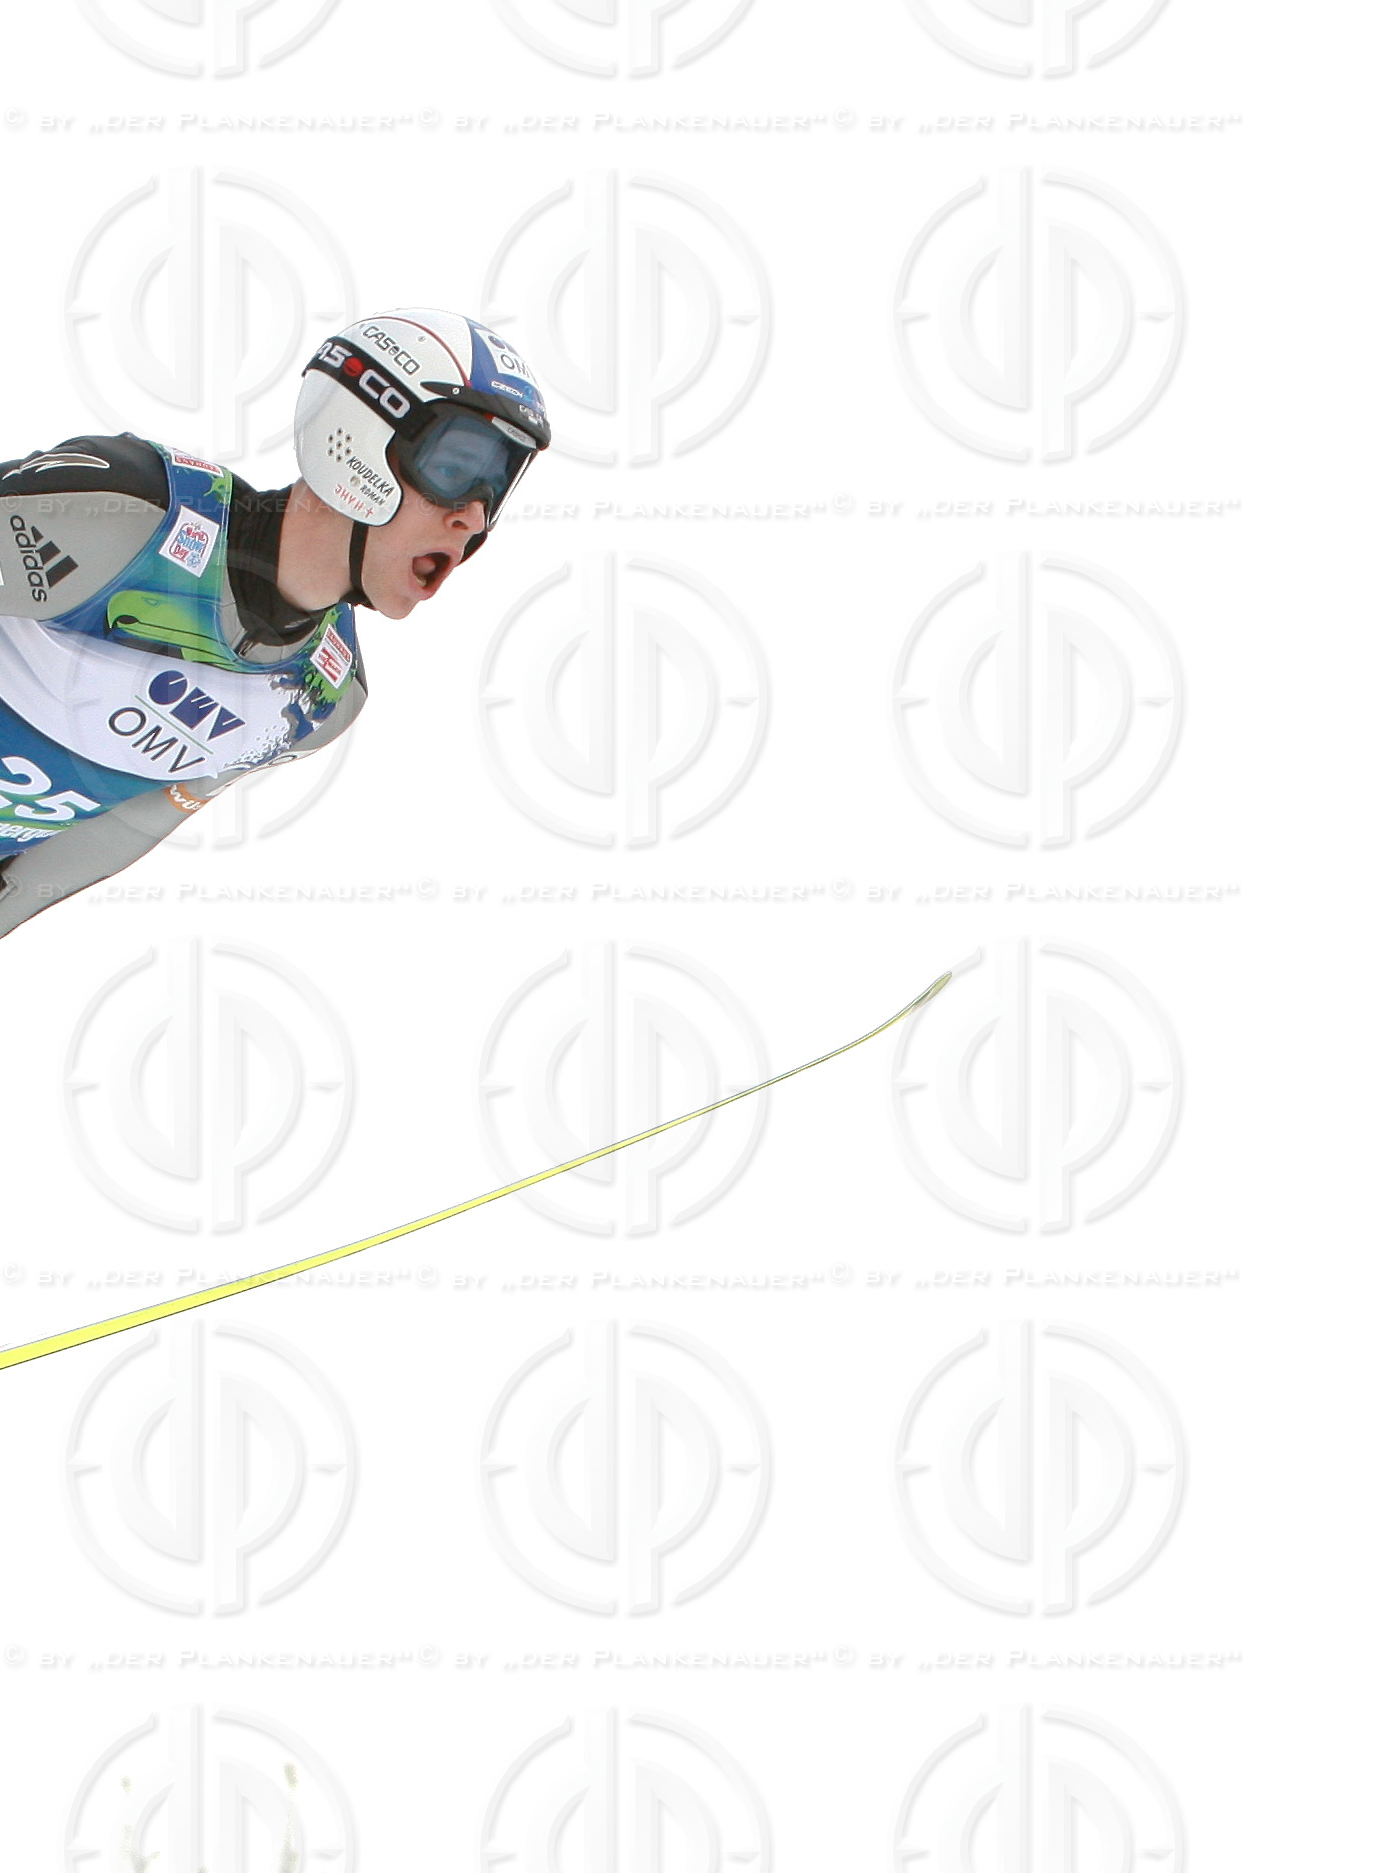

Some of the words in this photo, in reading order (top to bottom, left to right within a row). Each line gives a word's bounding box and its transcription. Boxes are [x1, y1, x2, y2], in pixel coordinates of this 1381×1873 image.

[316, 341, 411, 419] ASCO
[346, 455, 396, 497] KOUDELKA
[359, 484, 387, 506] ROMAN
[9, 514, 48, 603] adidas
[107, 706, 206, 774] OMV
